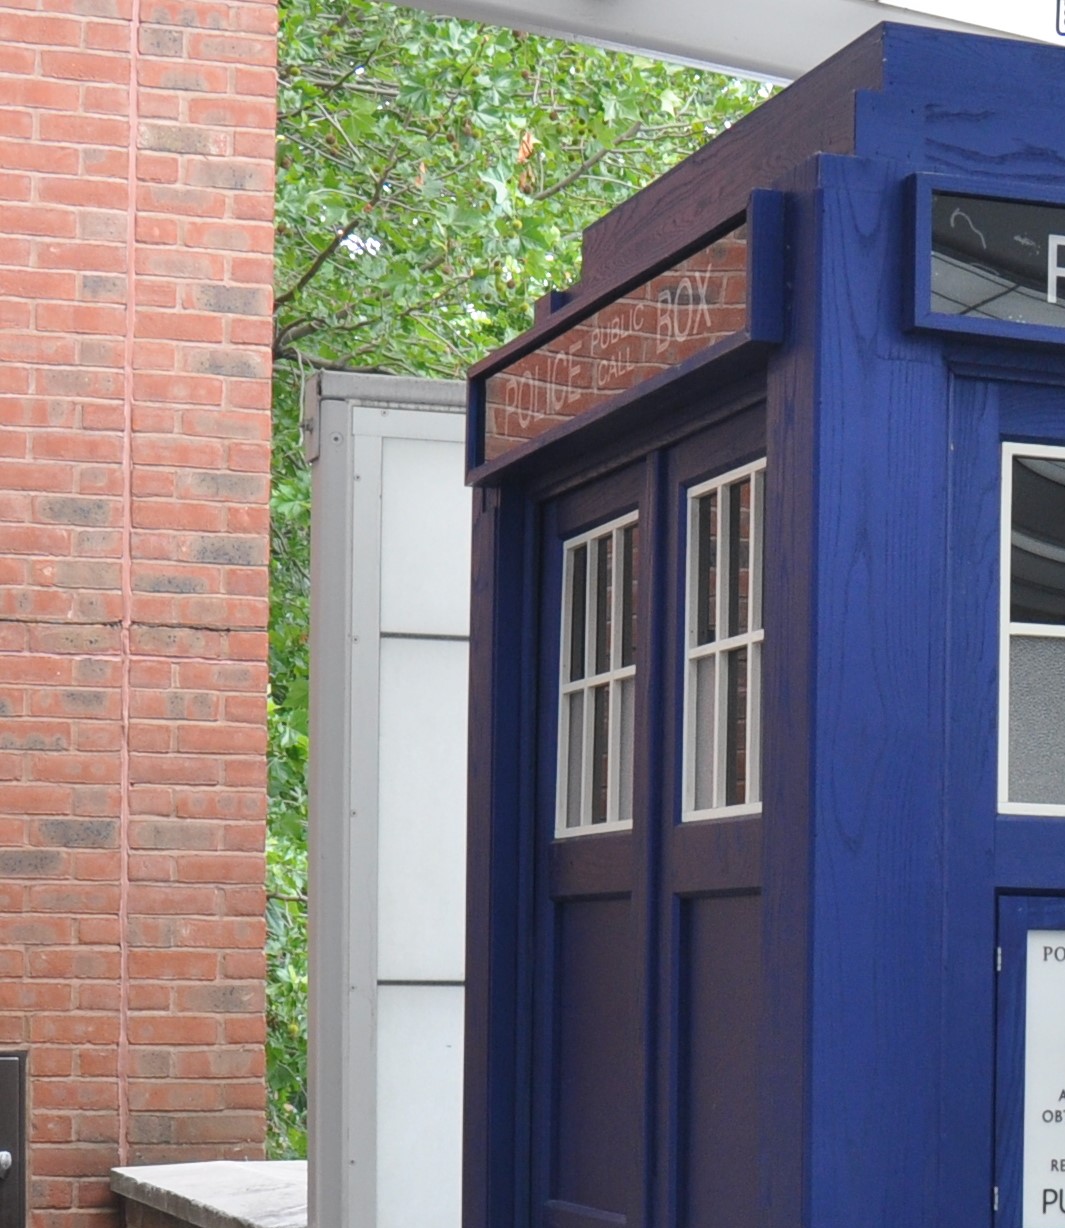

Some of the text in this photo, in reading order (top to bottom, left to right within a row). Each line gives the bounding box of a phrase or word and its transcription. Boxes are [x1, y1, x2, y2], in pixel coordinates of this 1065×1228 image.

[504, 263, 712, 436] POLICE PUBLIC CALL BOX
